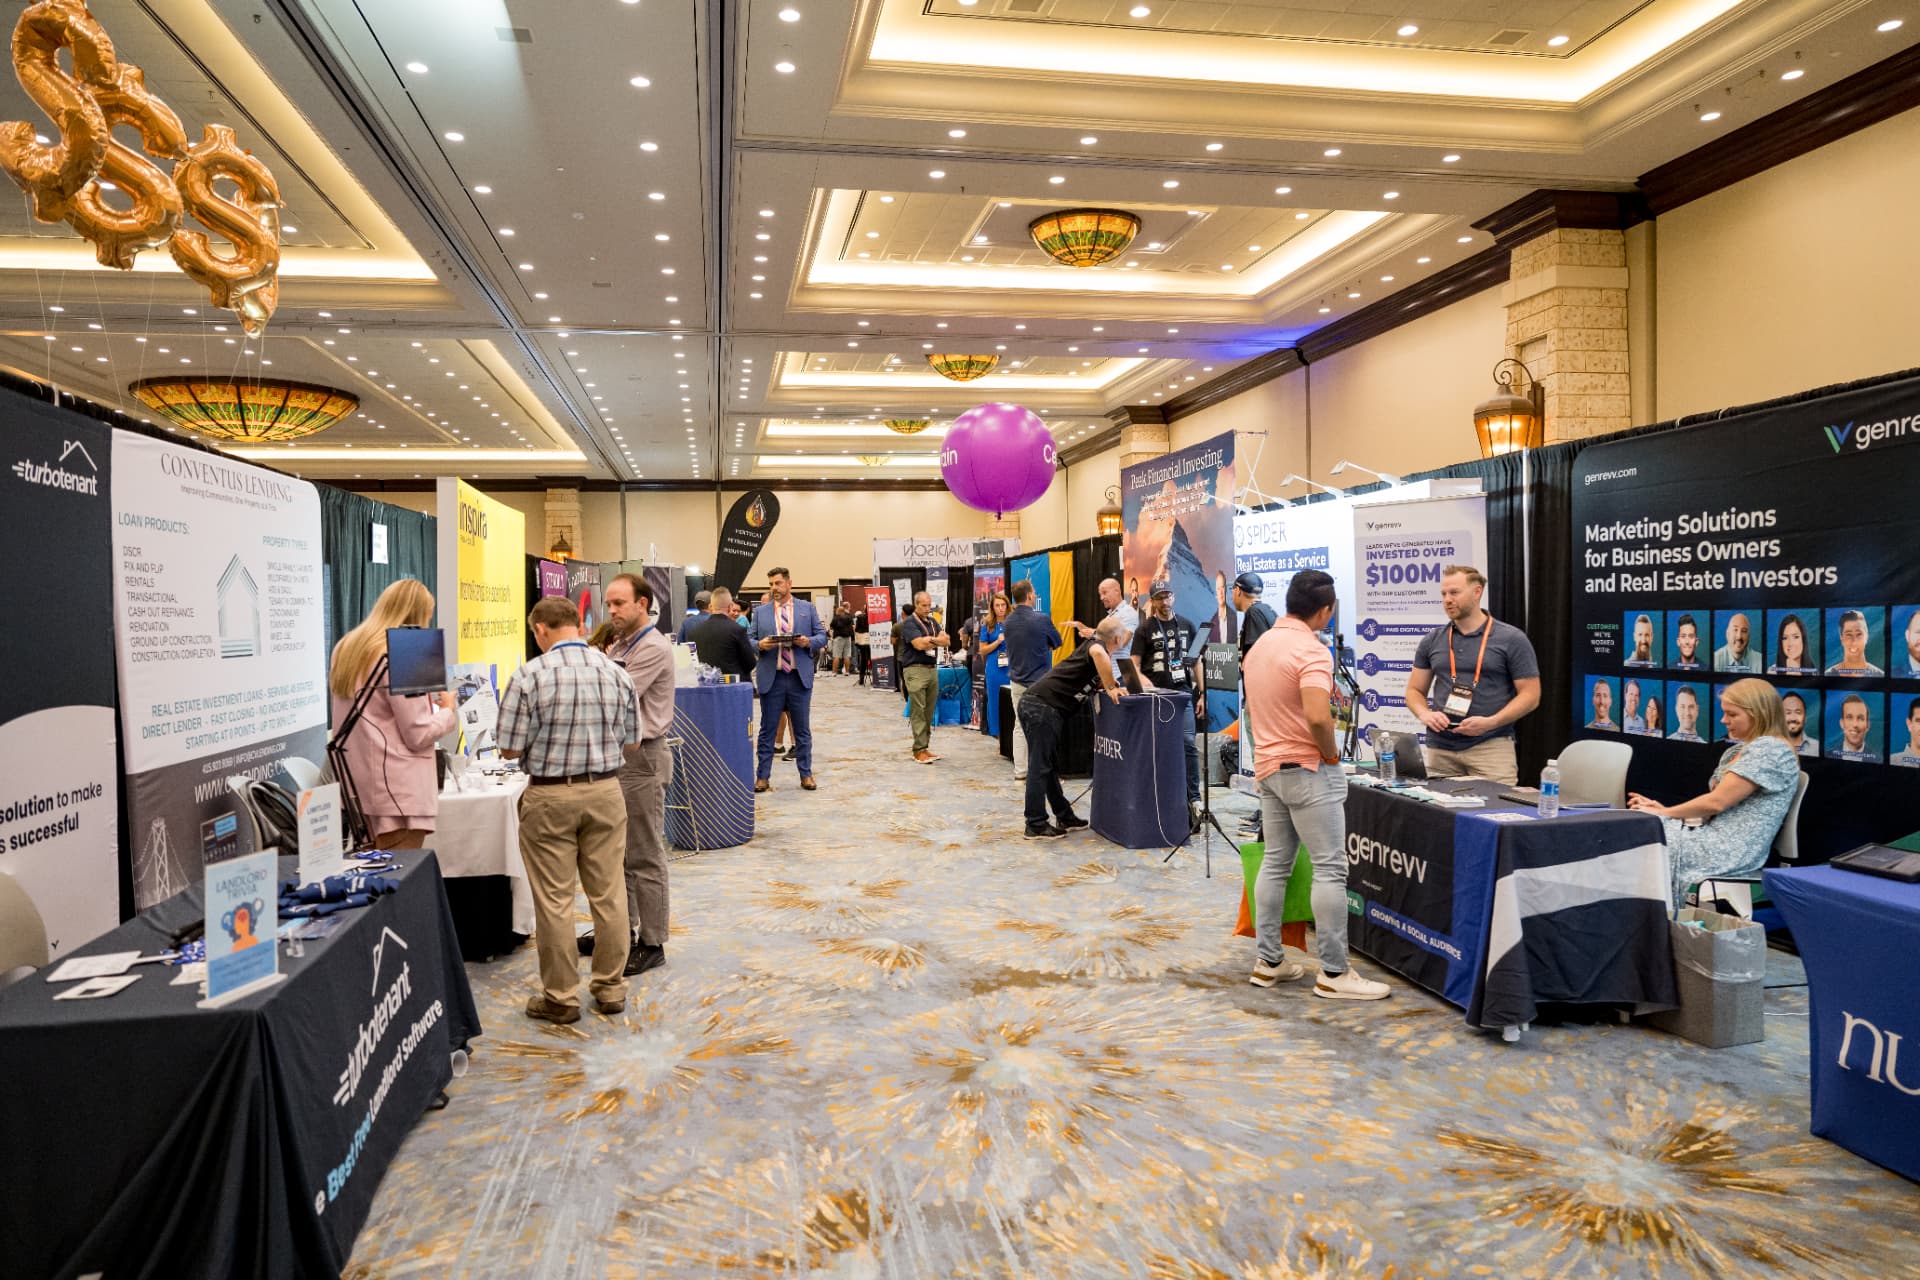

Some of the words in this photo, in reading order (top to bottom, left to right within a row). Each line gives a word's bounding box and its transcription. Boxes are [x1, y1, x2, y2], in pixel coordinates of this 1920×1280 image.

[1855, 414, 1920, 450] genre
[24, 458, 98, 497] turbotenant
[160, 452, 243, 493] CONVENTUS
[244, 473, 292, 503] LENDING
[1147, 461, 1182, 486] Financial
[1182, 448, 1223, 476] Investing
[1584, 467, 1637, 486] genrevv.com
[118, 511, 143, 528] LOAN
[144, 516, 190, 535] PRODUCTS:
[459, 490, 488, 540] inspira
[1585, 516, 1673, 543] Marketing
[1678, 506, 1777, 535] Solutions
[1247, 521, 1287, 546] SPIDER
[123, 545, 142, 557] DSCR
[1237, 557, 1252, 572] Real
[1252, 556, 1277, 571] Estate
[1277, 559, 1286, 569] as
[1287, 559, 1293, 568] a
[1294, 551, 1326, 569] Service
[1366, 549, 1420, 560] INVESTED
[1423, 547, 1455, 557] OVER
[1585, 548, 1608, 568] for
[1612, 544, 1692, 567] Business
[1697, 538, 1781, 562] Owners
[136, 562, 149, 573] AND
[1366, 562, 1441, 587] $100M
[1585, 572, 1616, 592] and
[1620, 571, 1658, 592] Real
[1663, 570, 1725, 591] Estate
[1731, 565, 1838, 589] Investors
[125, 576, 155, 588] RENTALS
[126, 591, 179, 604] TRANSACTIONAL
[867, 593, 888, 608] EOS
[128, 606, 146, 617] CASH
[147, 607, 160, 618] OUT
[129, 621, 170, 632] RENOVATION
[130, 636, 159, 648] GROUND
[160, 636, 168, 646] UP
[1212, 647, 1233, 665] people
[151, 704, 173, 718] REAL
[174, 700, 202, 714] ESTATE
[203, 693, 243, 710] INVESTMENT
[142, 723, 172, 740] DIRECT
[173, 717, 202, 734] LENDER
[210, 714, 227, 727] FAST
[228, 707, 255, 723] CLOSING
[185, 734, 220, 750] STARTING
[220, 731, 229, 742] AT
[234, 725, 256, 740] POINTS
[1097, 735, 1124, 760] SPIDER
[57, 791, 69, 808] to
[71, 781, 103, 805] make
[9, 811, 79, 850] successful
[1347, 832, 1427, 884] genrevv
[216, 869, 267, 894] LANDLORD
[227, 884, 258, 901] TRIVIA
[1370, 908, 1400, 929] GROWING
[1401, 922, 1407, 932] A
[1407, 925, 1428, 944] SOCIAL
[1429, 937, 1462, 961] AUDIENCE
[348, 960, 412, 1098] turbotenant
[327, 1142, 356, 1203] Best
[369, 1044, 402, 1123] Landlord
[401, 999, 444, 1061] Software
